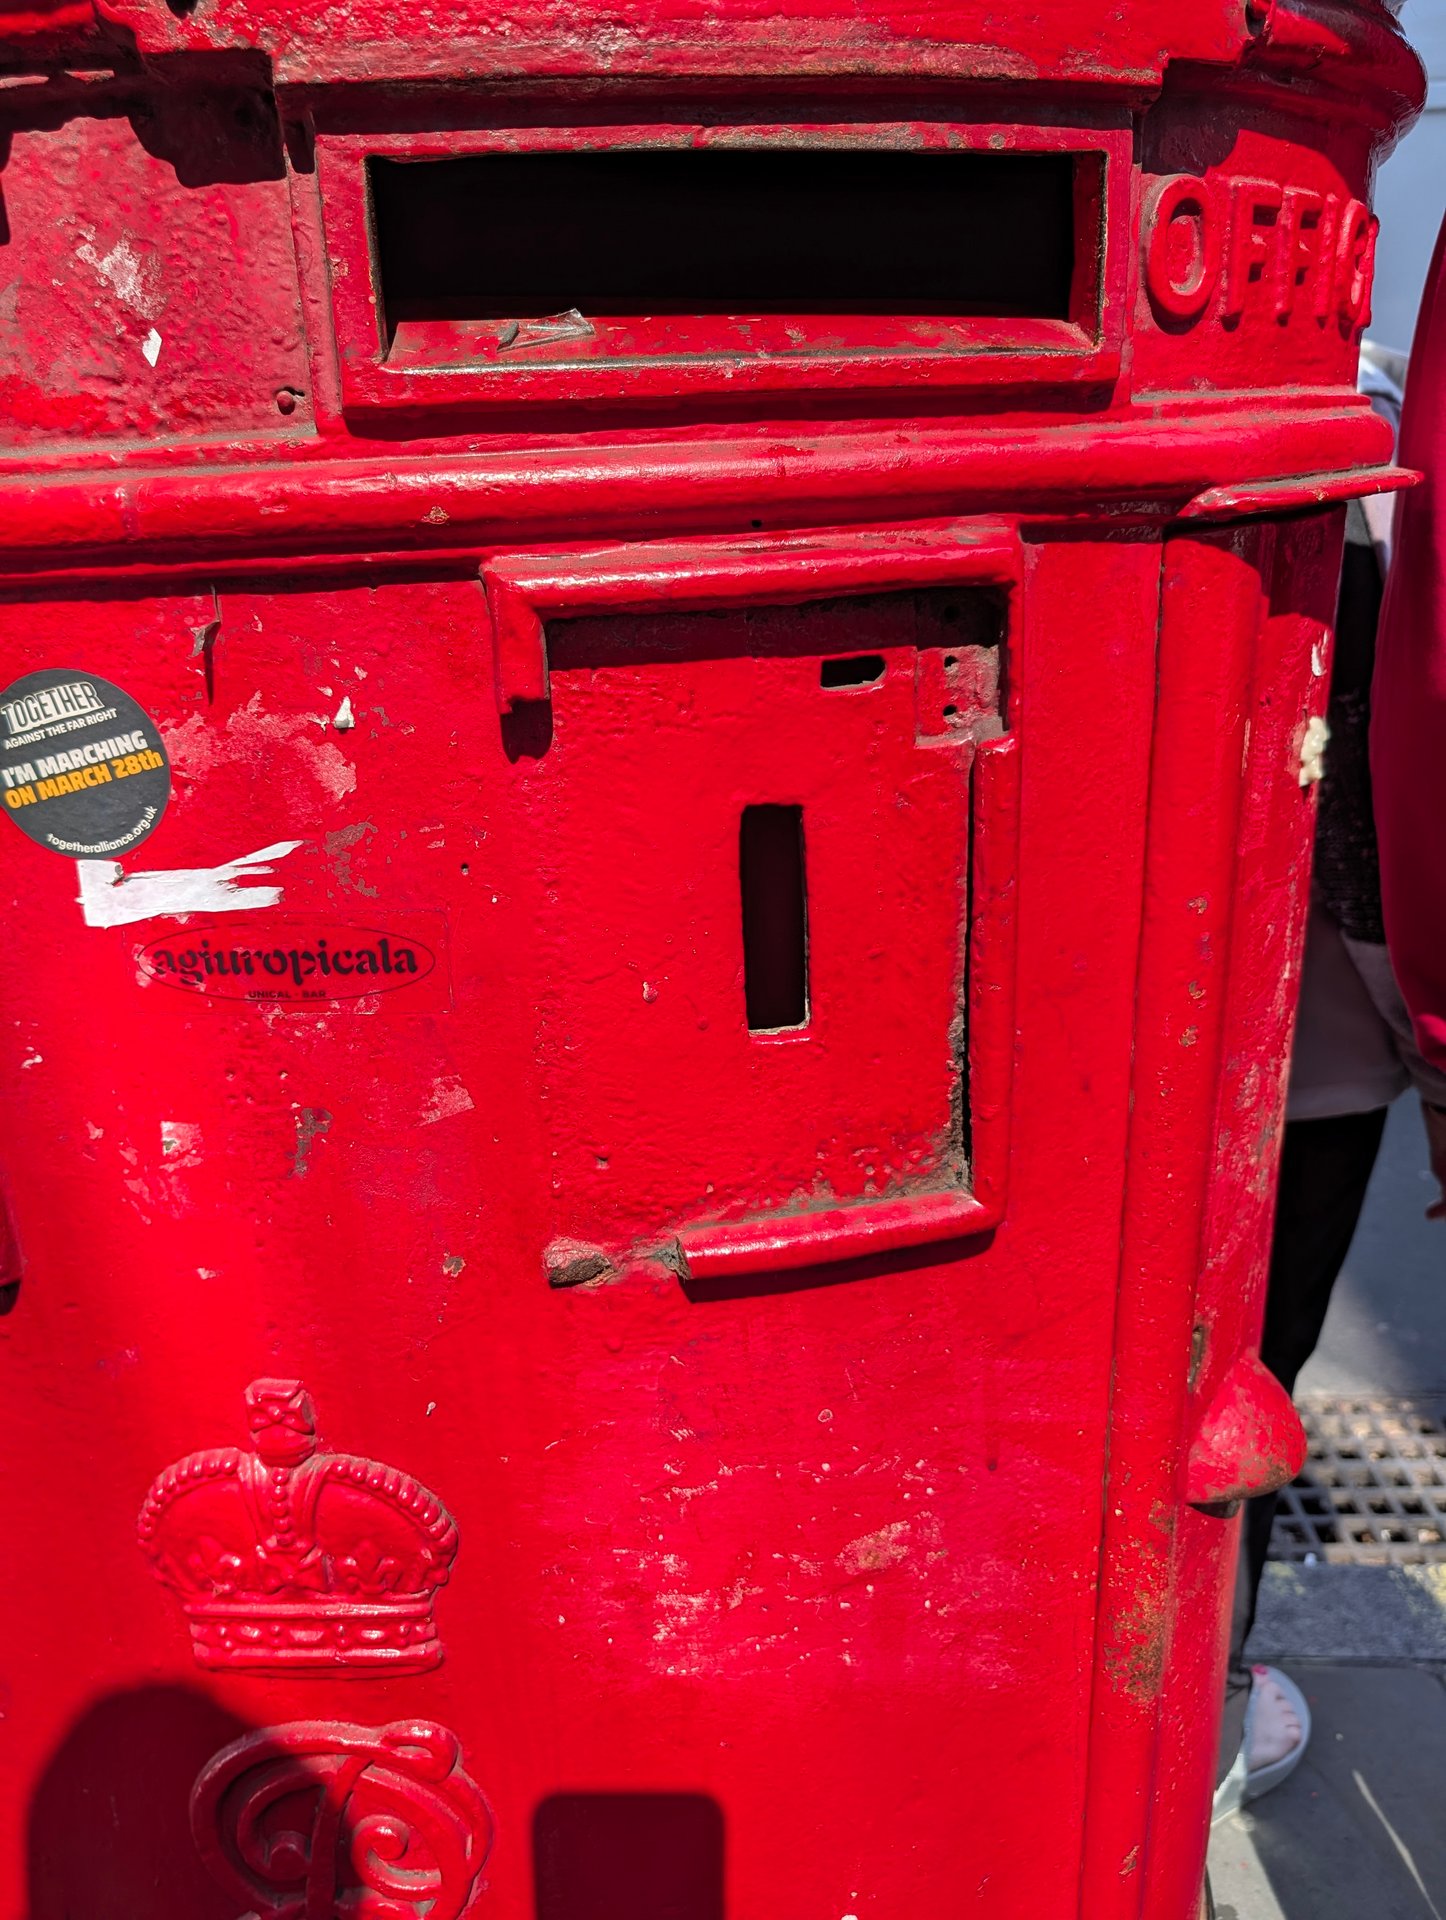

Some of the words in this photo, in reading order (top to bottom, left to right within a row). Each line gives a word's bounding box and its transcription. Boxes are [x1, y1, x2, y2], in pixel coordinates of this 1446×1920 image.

[1, 681, 105, 734] TOGETHER
[5, 730, 46, 750] AGAINST
[46, 721, 68, 737] THE
[66, 716, 87, 731] FAR
[86, 708, 117, 726] RIGHT
[2, 762, 38, 787] I'M
[36, 730, 148, 778] MARCHING
[5, 785, 38, 809] ON
[36, 763, 112, 801] MARCH
[111, 749, 164, 779] 28th
[47, 805, 157, 853] togetheralliance.org.uk
[302, 990, 327, 998] BAR
